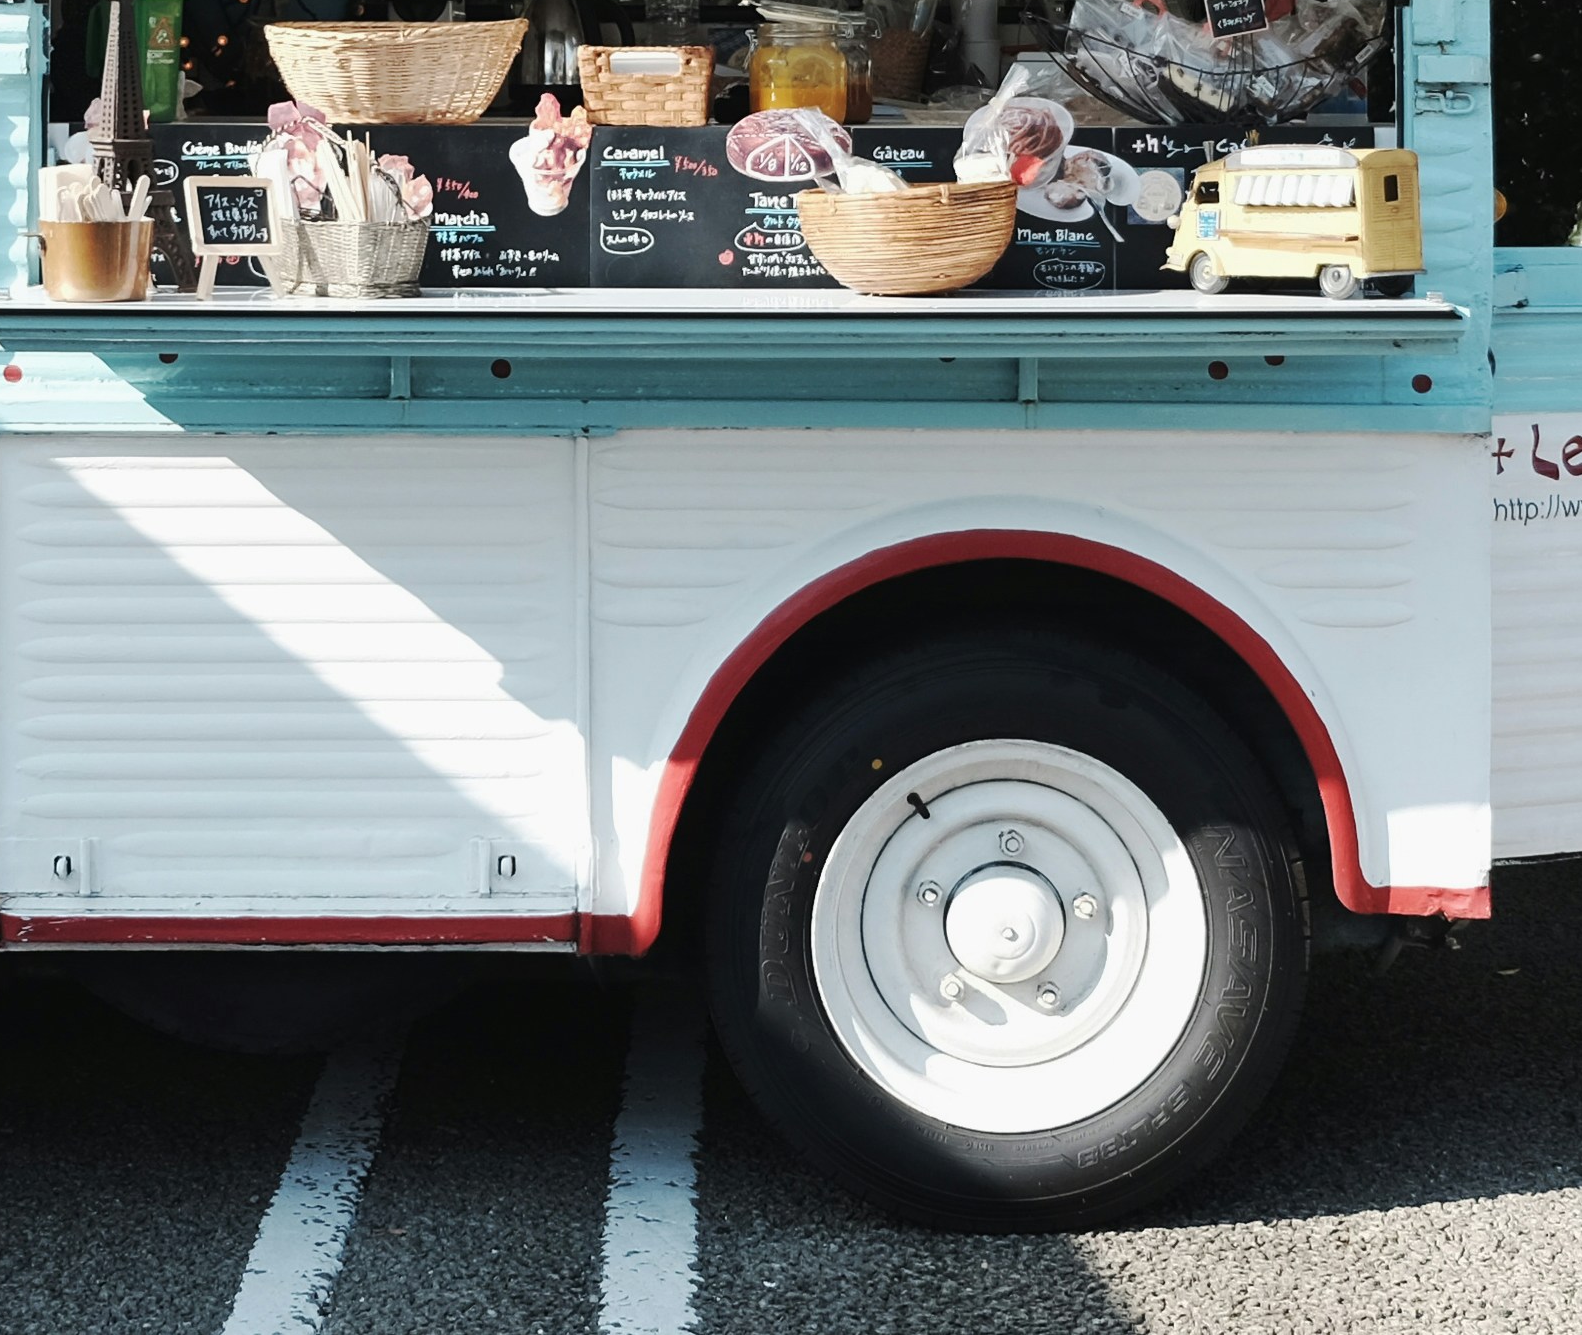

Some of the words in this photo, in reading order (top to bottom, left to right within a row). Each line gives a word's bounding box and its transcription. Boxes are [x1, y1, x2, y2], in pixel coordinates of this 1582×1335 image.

[603, 145, 665, 162] Caramel
[872, 145, 925, 161] Gâteau
[434, 210, 489, 227] Matcha
[1017, 227, 1052, 243] Mont
[1055, 228, 1095, 242] Blanc
